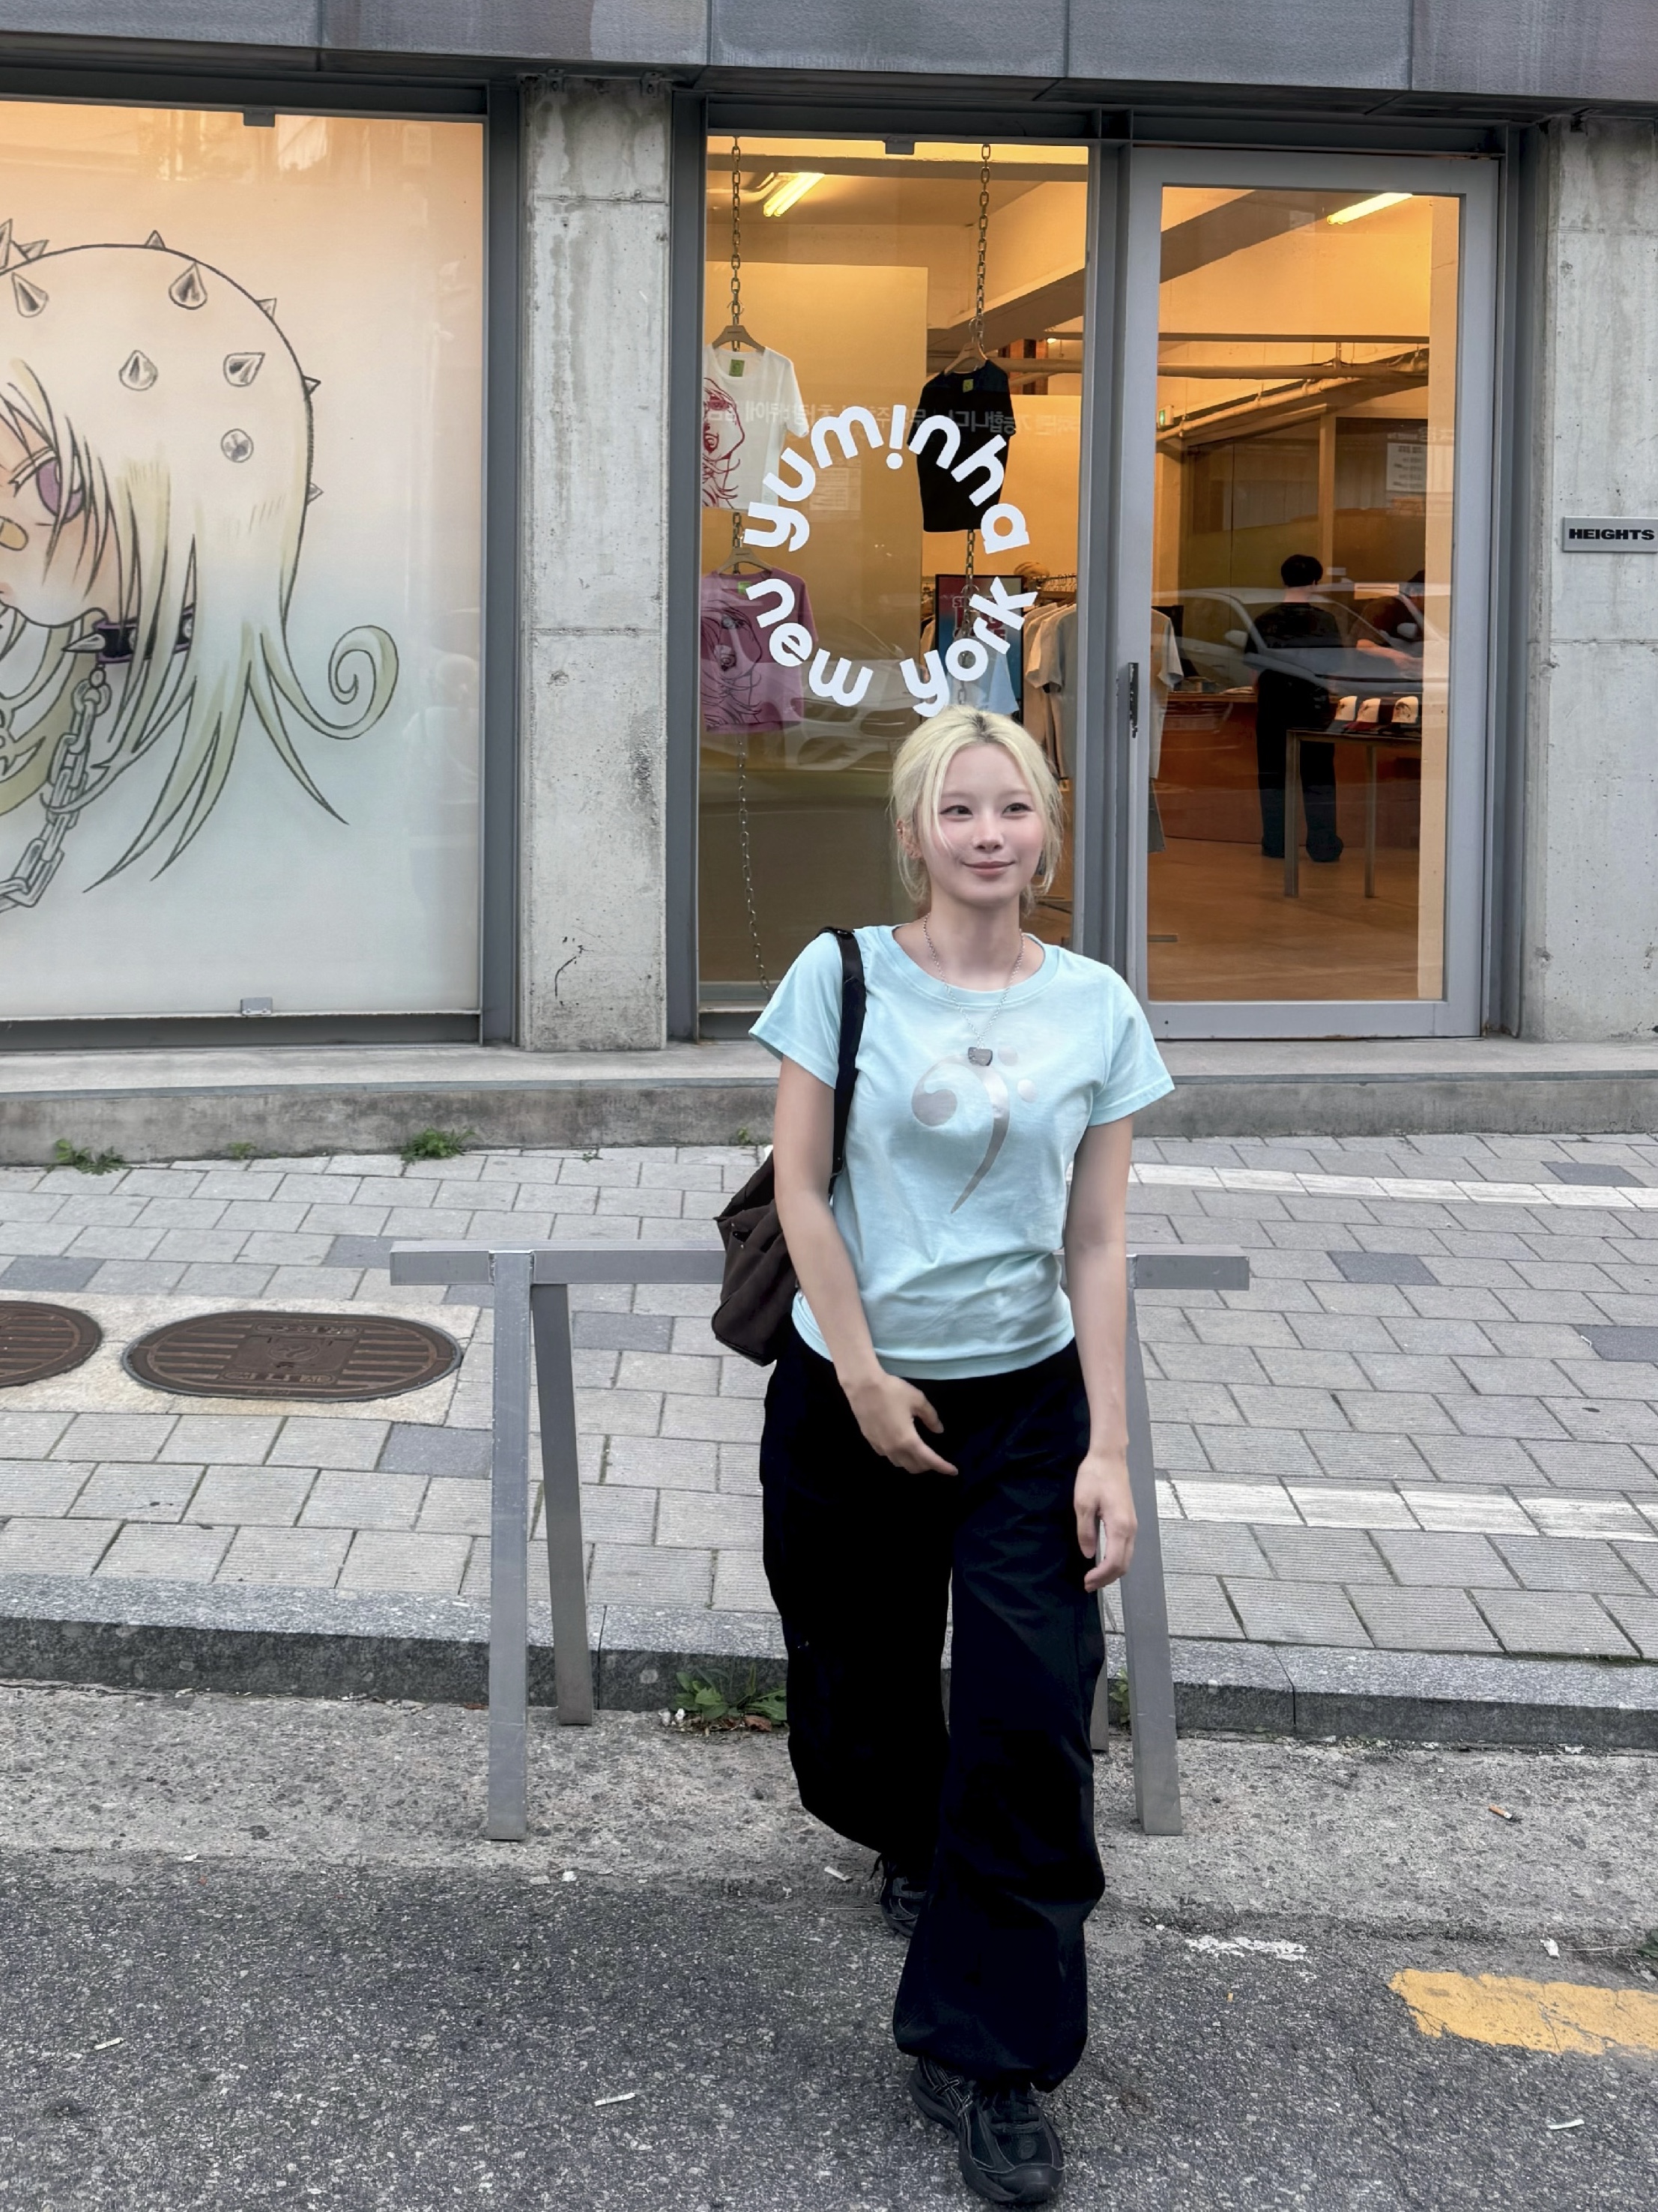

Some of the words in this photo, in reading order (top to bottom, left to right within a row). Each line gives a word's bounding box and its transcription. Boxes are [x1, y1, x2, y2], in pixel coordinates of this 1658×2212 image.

[742, 404, 1031, 555] yuminha
[1569, 528, 1655, 540] HEIGHTS
[745, 578, 874, 707] new
[899, 575, 1039, 719] york
